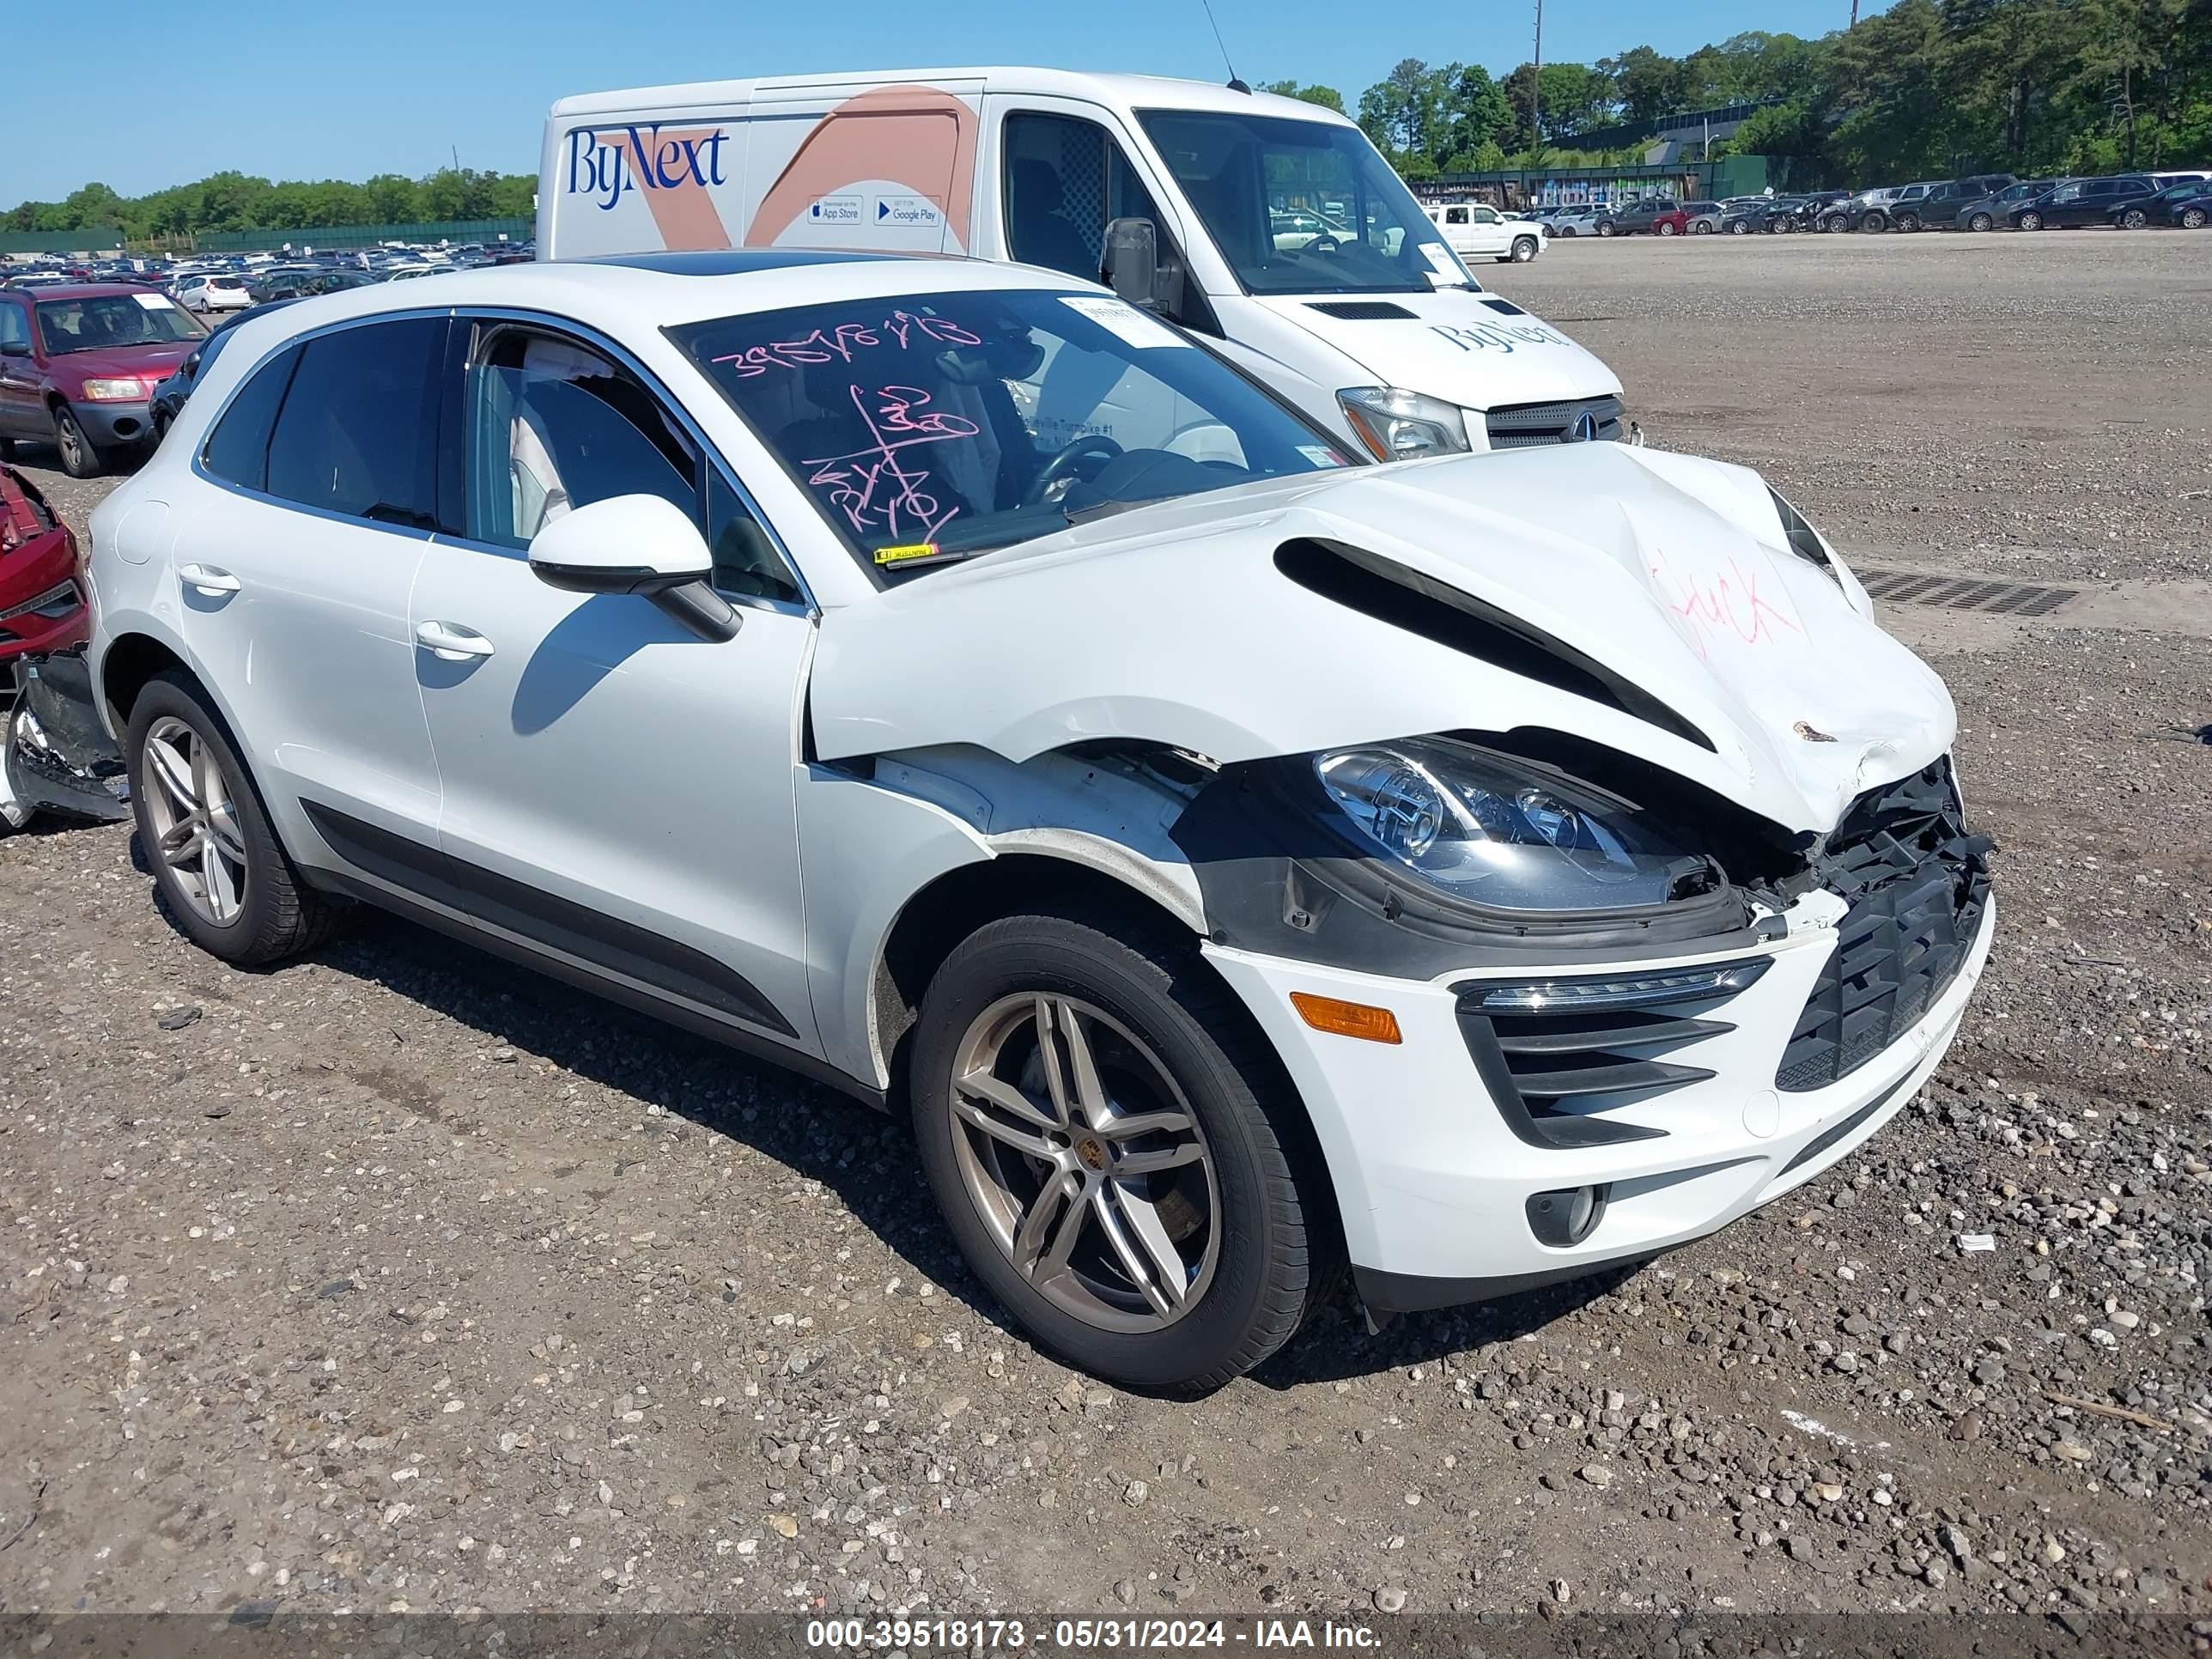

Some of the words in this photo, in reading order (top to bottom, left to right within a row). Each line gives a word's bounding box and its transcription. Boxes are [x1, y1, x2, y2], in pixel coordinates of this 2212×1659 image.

[567, 124, 729, 210] ByNext
[823, 208, 837, 220] App
[838, 208, 858, 219] Store
[893, 208, 919, 222] Google
[921, 209, 935, 222] Play
[1426, 320, 1570, 353] ByNext
